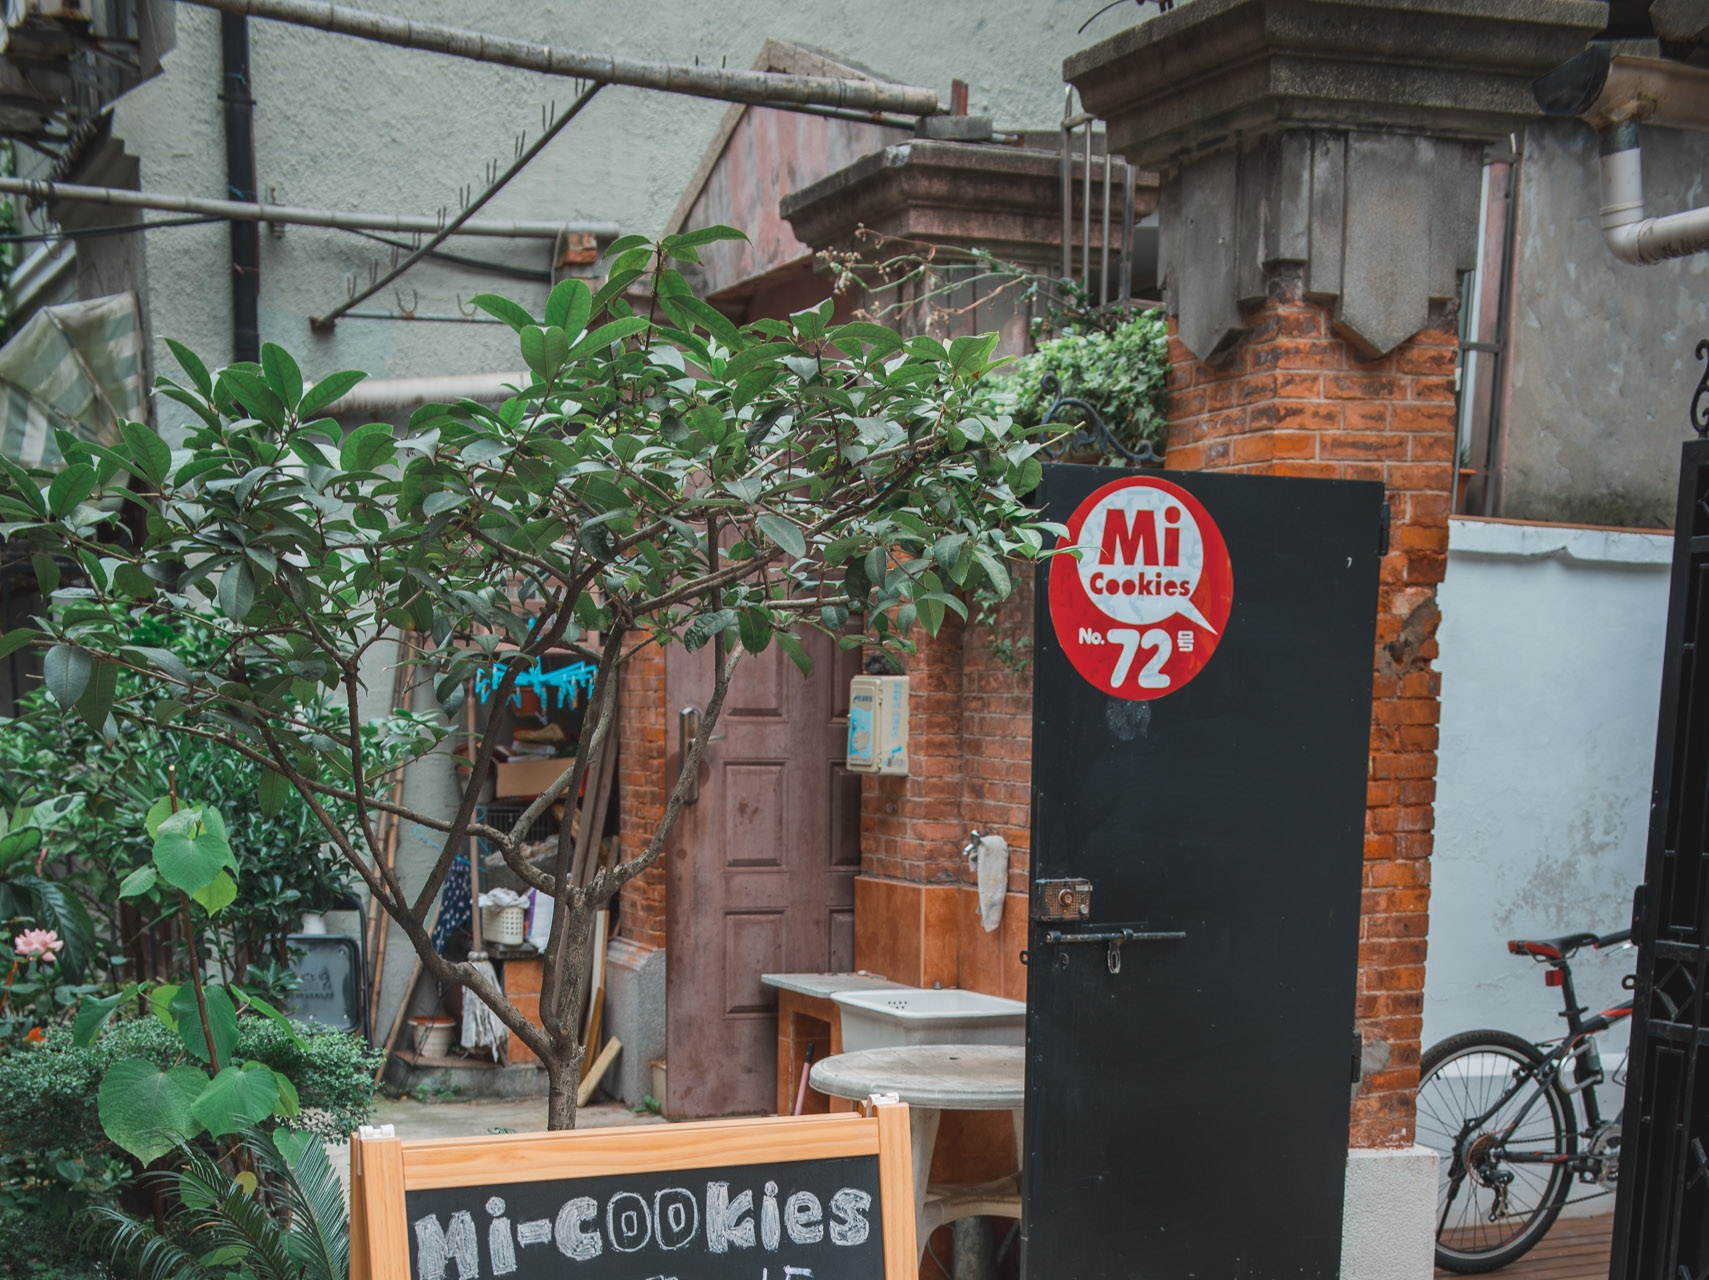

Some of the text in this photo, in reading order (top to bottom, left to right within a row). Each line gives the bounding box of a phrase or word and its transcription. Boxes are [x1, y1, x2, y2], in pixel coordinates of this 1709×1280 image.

[1099, 505, 1181, 567] Mi
[1089, 571, 1190, 596] Cookies
[1079, 627, 1105, 646] No.
[1107, 628, 1173, 688] 72
